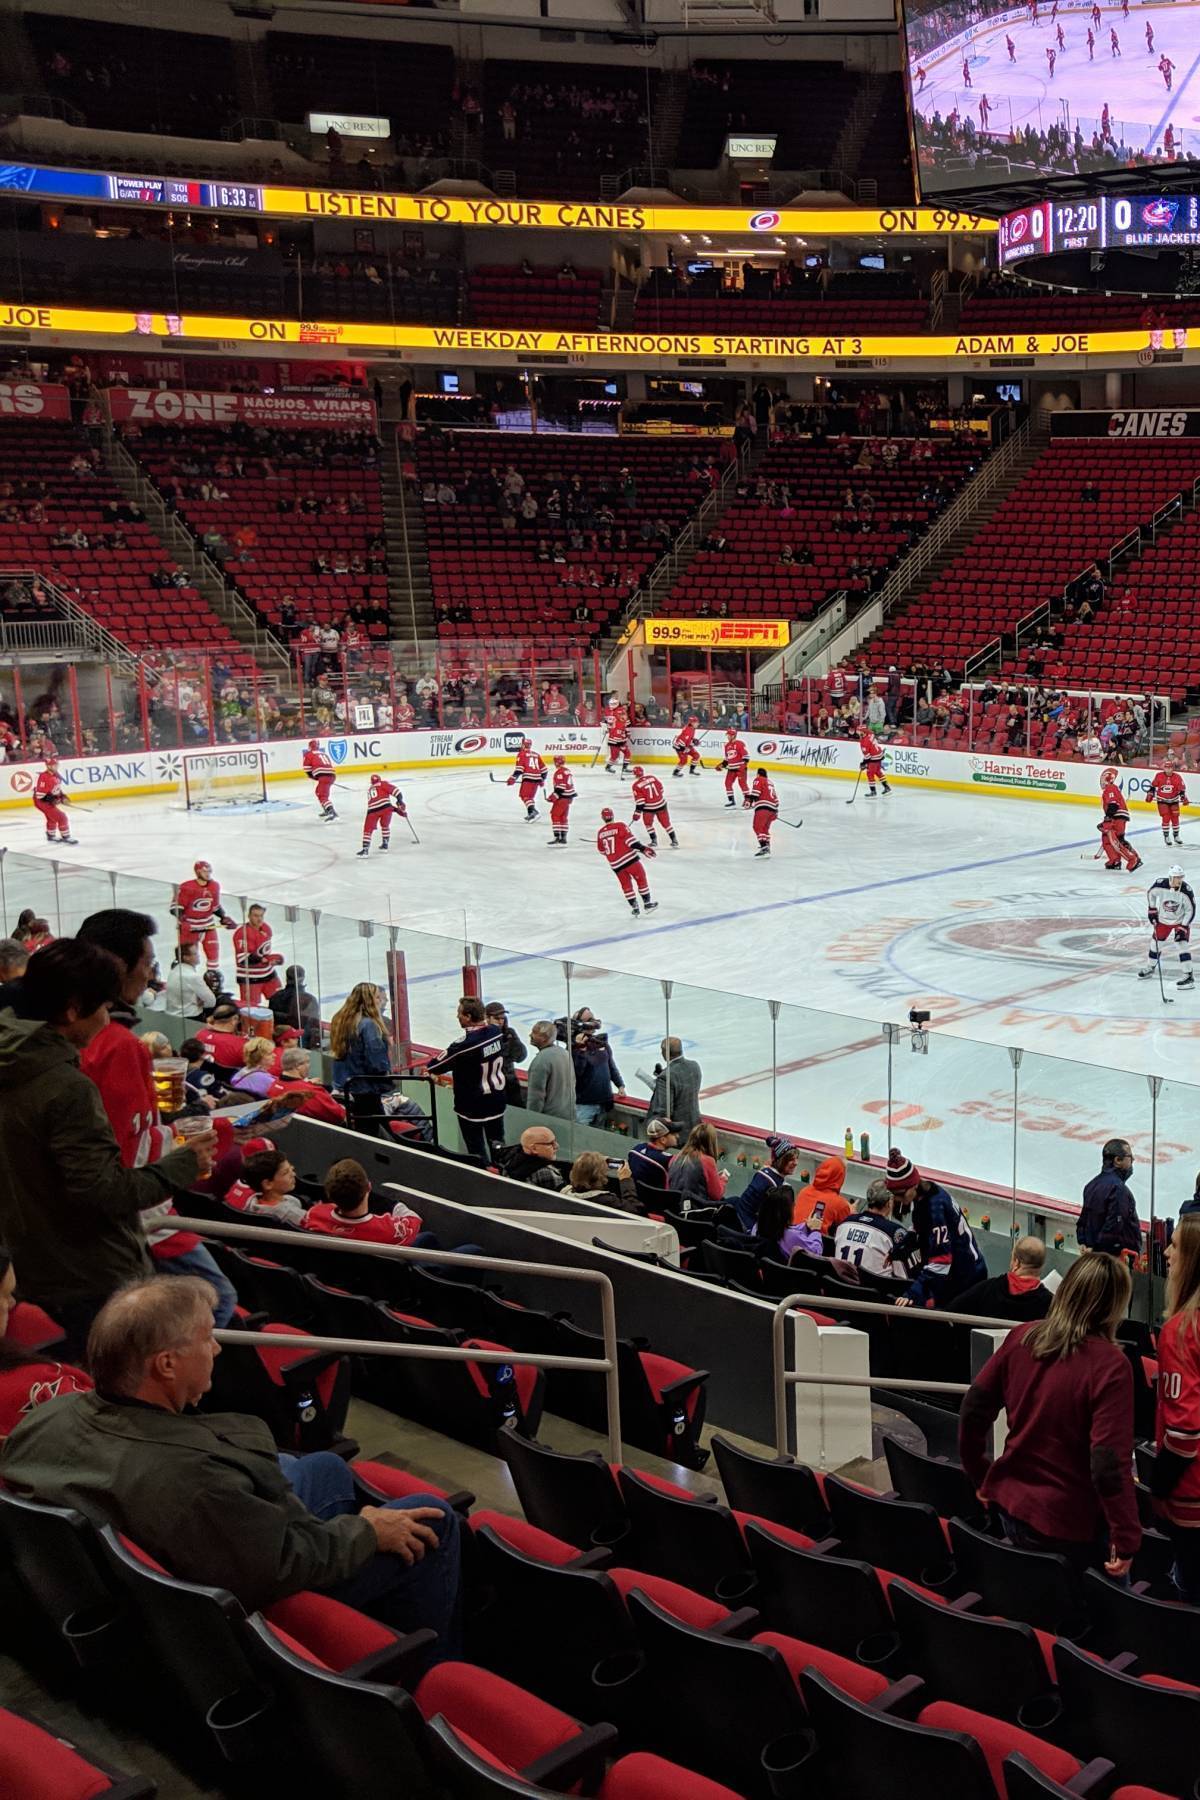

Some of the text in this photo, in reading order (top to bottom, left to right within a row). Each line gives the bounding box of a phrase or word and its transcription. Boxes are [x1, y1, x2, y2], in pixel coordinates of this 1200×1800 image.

[325, 119, 375, 132] UNC REX
[731, 143, 775, 154] UNC REX
[118, 179, 162, 190] POWER PLAY
[171, 194, 188, 203] SOG
[221, 187, 246, 207] 6:33
[304, 191, 645, 230] LISTEN TO YOUR CANES
[1057, 205, 1098, 233] 12:20
[1114, 200, 1131, 230] 0
[879, 210, 917, 232] ON
[1032, 209, 1044, 239] 0
[1064, 237, 1088, 248] FIRST
[1125, 233, 1153, 244] BLUE
[3, 307, 52, 327] JOE
[249, 322, 286, 340] ON
[434, 330, 863, 355] WEEKDAY AFTERNOONS STARTING AT 3
[956, 334, 1089, 354] ADAM & JOE
[1139, 350, 1153, 362] 116
[127, 391, 240, 421] ZONE
[313, 399, 371, 412] WRAPS
[1107, 412, 1187, 437] CANES
[652, 627, 681, 639] 99.9
[720, 623, 778, 639] ESPN
[354, 740, 382, 758] NC
[430, 734, 453, 744] STREAM
[430, 736, 524, 757] LIVE ON FOX
[630, 738, 672, 746] VECTOR
[894, 750, 918, 763] DUKE
[88, 761, 146, 782] BANK
[895, 762, 930, 777] ENERGY
[984, 760, 1066, 780] Harris Teeter
[480, 1056, 506, 1096] 10
[846, 1227, 870, 1244] WEBB
[932, 1225, 950, 1245] 72
[840, 1245, 864, 1267] 11
[1163, 1371, 1182, 1399] 20
